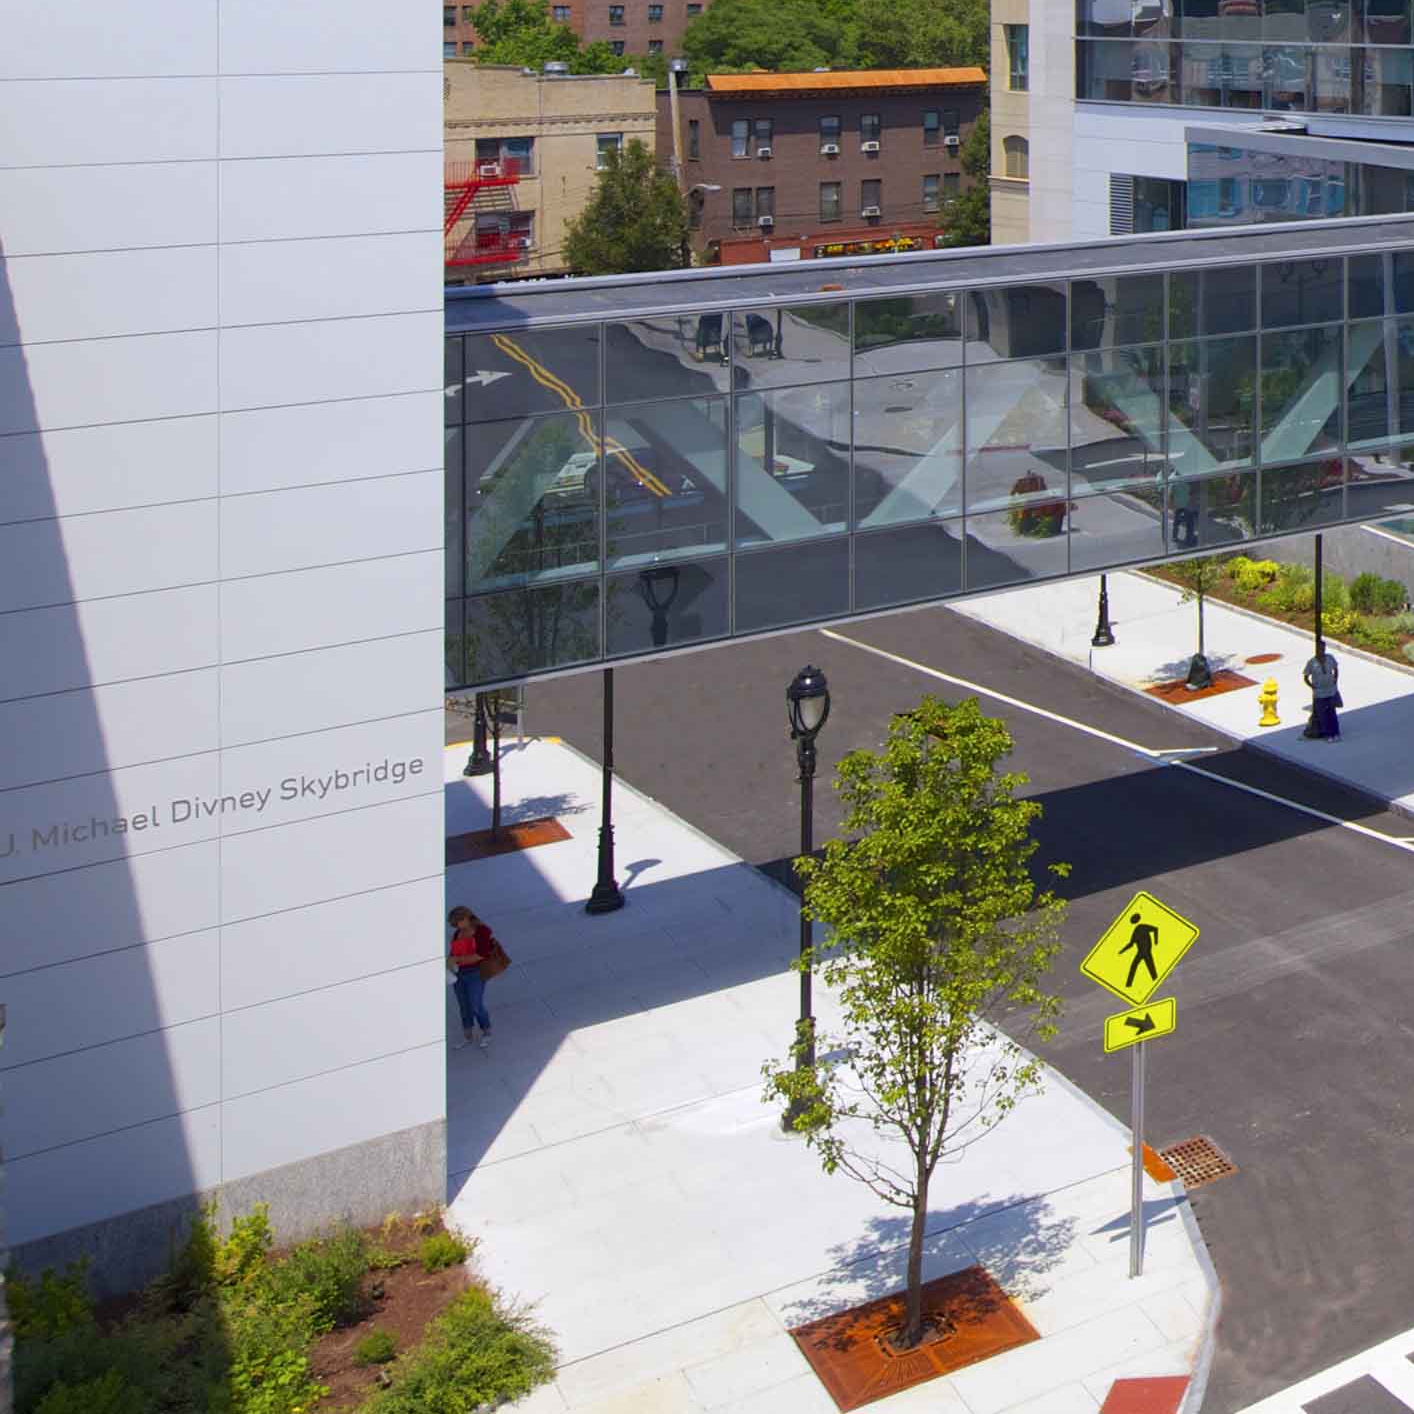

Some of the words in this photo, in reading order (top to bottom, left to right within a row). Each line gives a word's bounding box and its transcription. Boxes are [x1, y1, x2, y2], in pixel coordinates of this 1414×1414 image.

[31, 805, 161, 851] Michael
[172, 788, 272, 824] Divney
[280, 757, 424, 801] Skybridge
